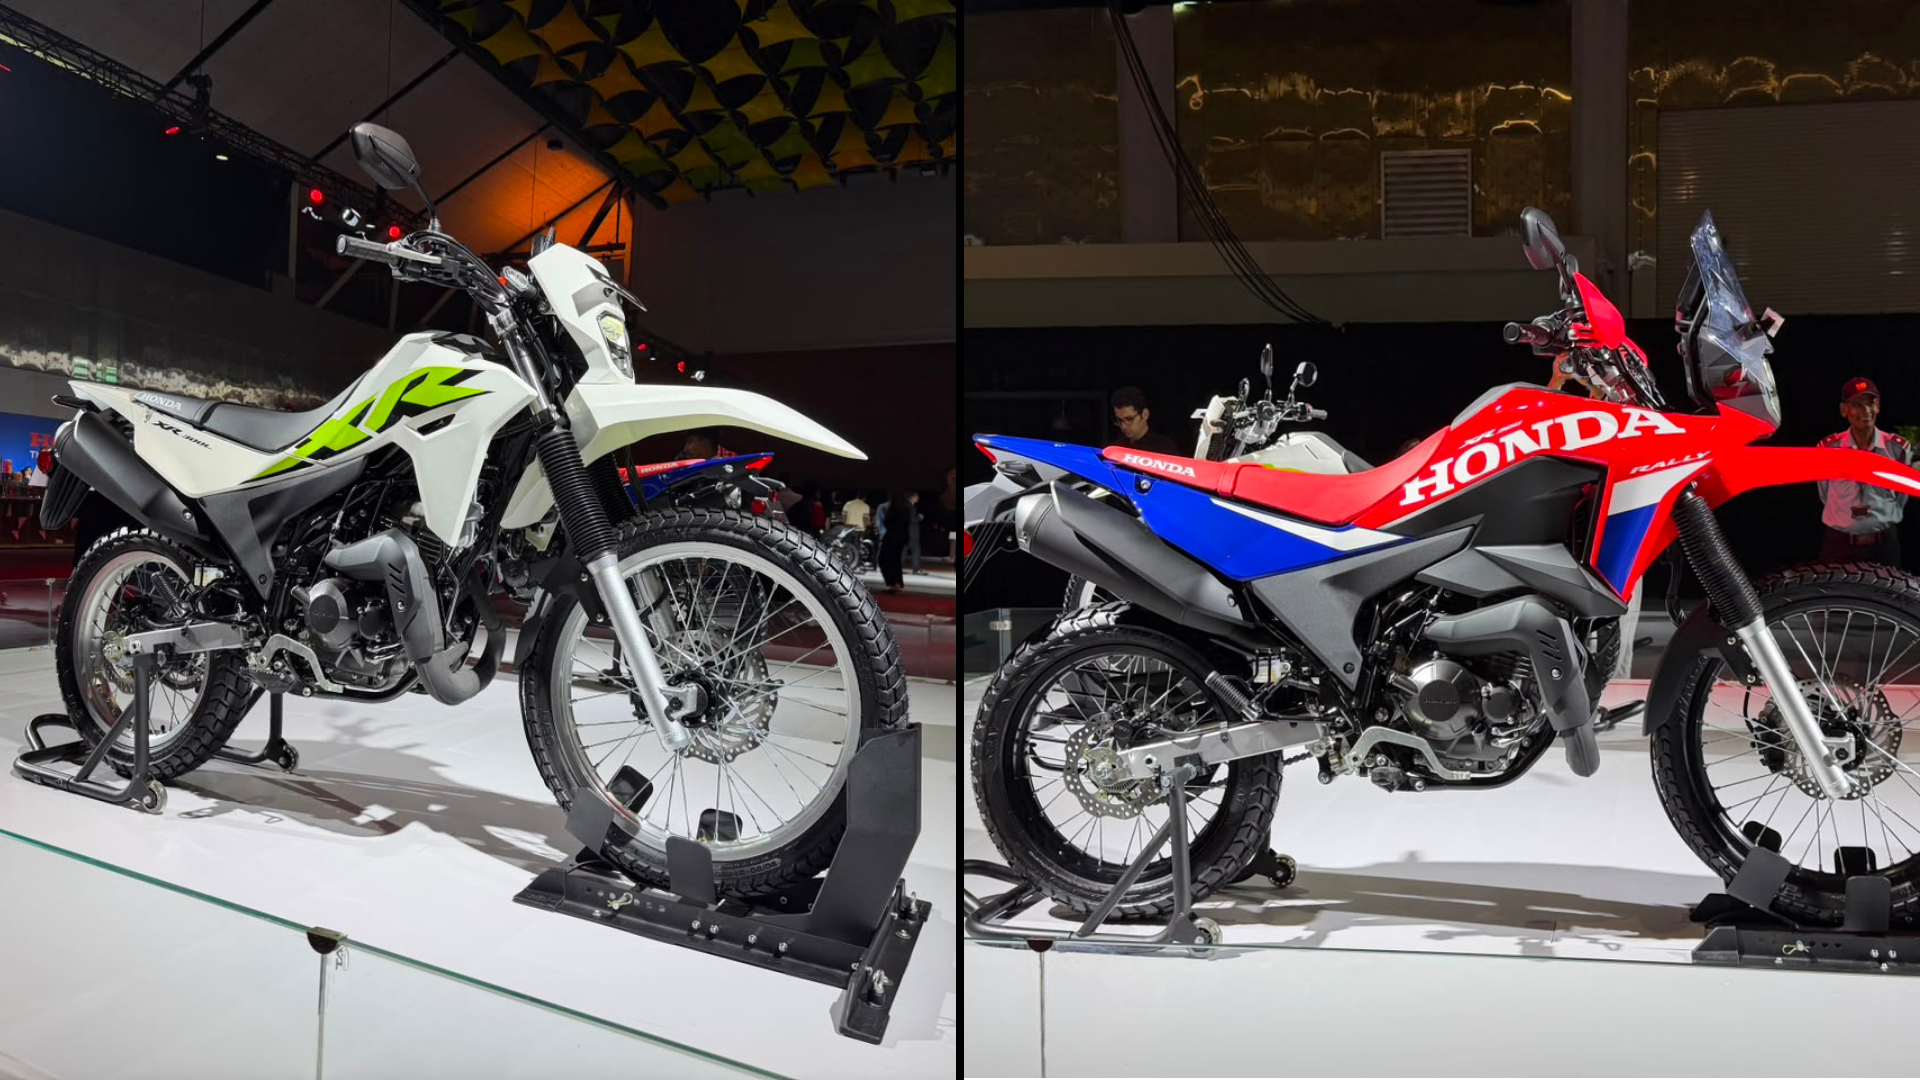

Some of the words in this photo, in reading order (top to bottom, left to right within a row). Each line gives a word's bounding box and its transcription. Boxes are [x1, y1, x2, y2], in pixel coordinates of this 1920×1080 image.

[140, 393, 182, 411] HONDA
[641, 462, 678, 474] HONDA
[1123, 453, 1197, 478] HONDA
[1399, 407, 1687, 506] HONDA
[1629, 450, 1712, 475] RALLY
